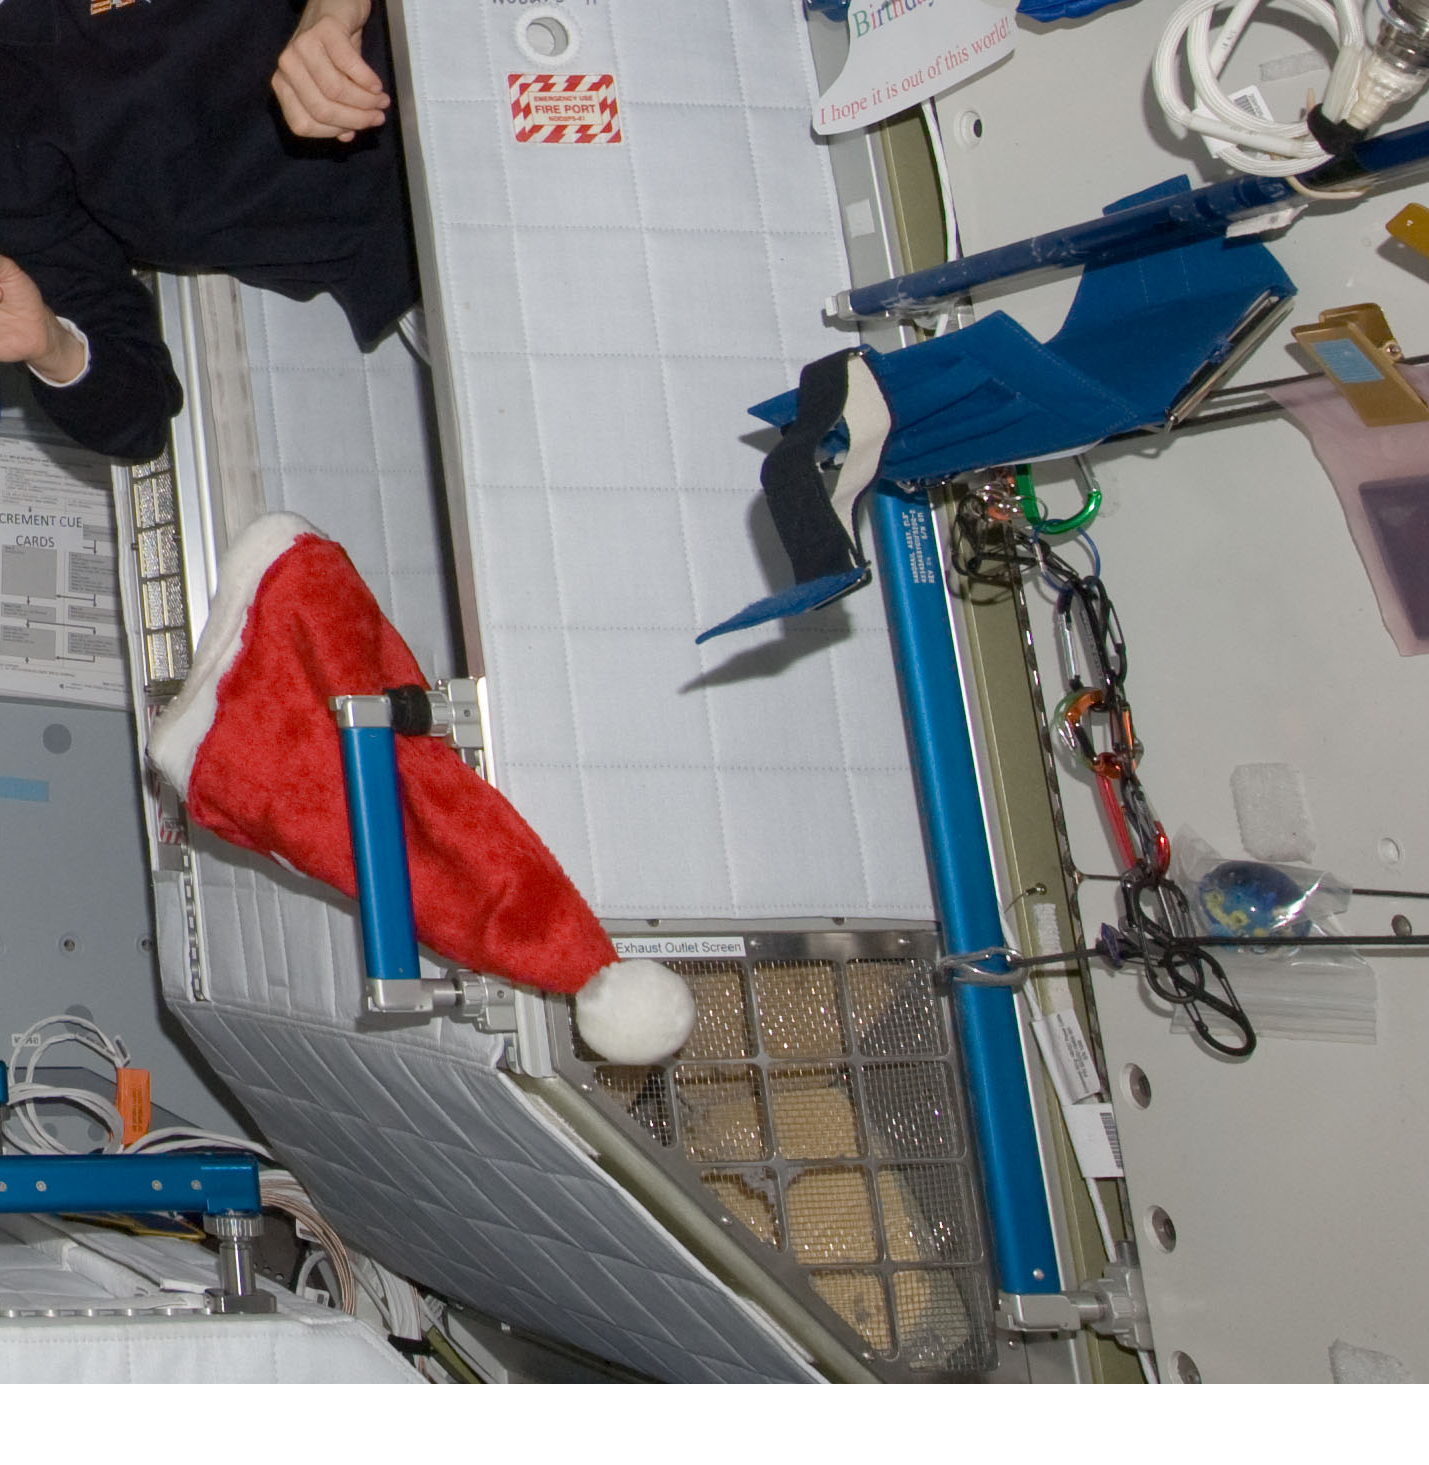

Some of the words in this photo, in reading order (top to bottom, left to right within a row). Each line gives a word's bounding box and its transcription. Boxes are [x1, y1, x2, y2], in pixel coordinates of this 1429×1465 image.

[820, 107, 827, 126] I
[831, 96, 868, 121] hope
[872, 87, 884, 106] it
[885, 82, 899, 99] is
[901, 70, 925, 92] out
[927, 55, 942, 79] of
[944, 44, 970, 71] this
[971, 16, 1012, 55] world!
[534, 103, 560, 115] FIRE
[564, 103, 597, 115] PORT
[59, 516, 83, 528] CUE
[15, 534, 55, 548] CARDS
[615, 939, 663, 953] Exhaust
[664, 939, 700, 953] Outlet
[701, 940, 742, 953] Screen
